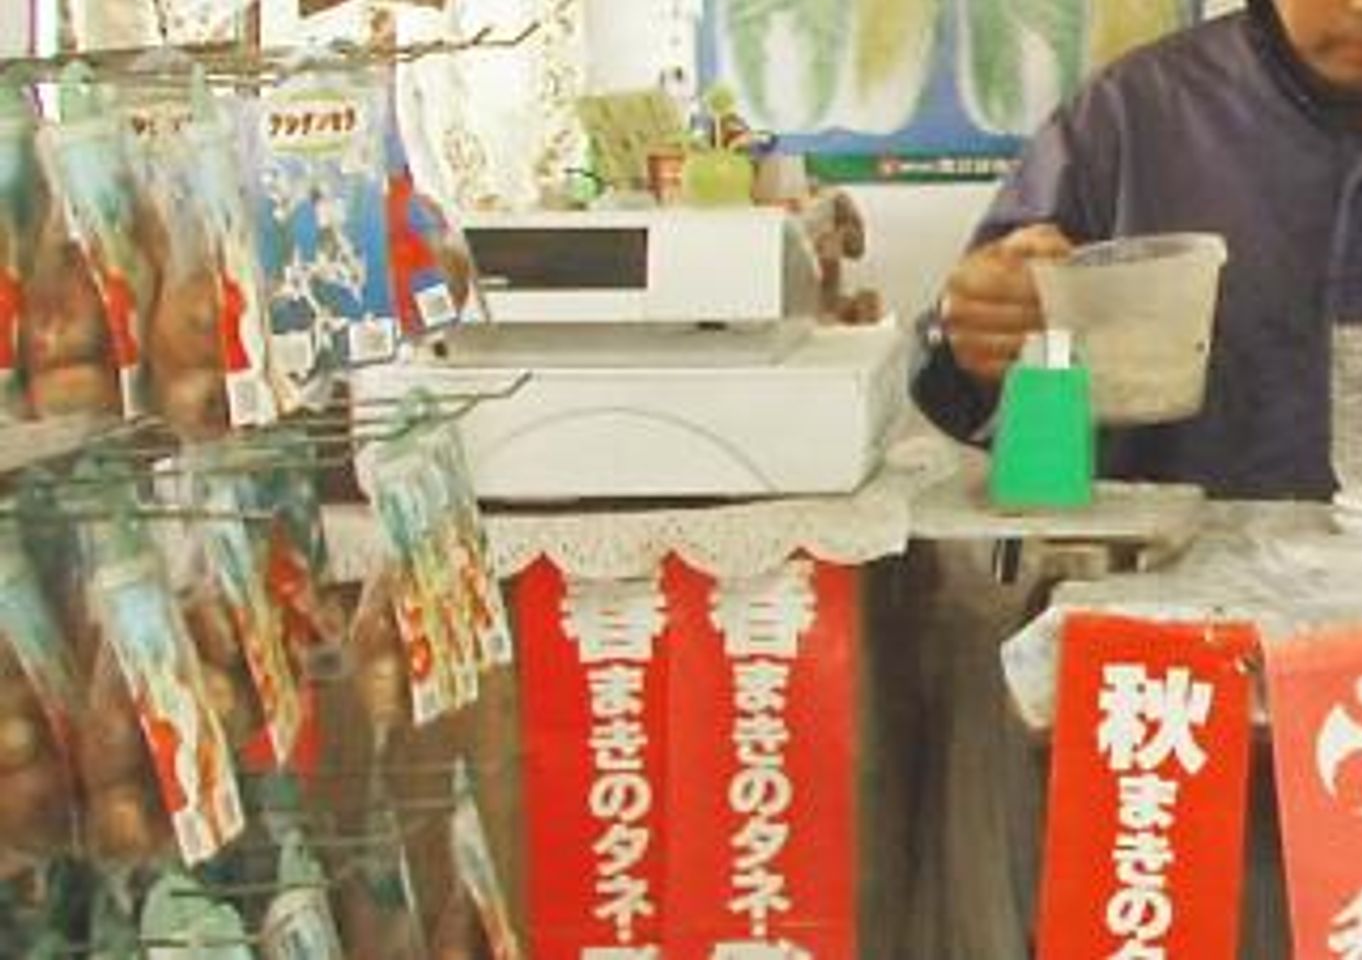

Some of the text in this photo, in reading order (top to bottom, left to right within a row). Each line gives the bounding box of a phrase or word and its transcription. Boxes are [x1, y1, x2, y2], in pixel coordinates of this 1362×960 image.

[559, 574, 669, 960] 春まきのタネ
[709, 570, 816, 960] 春まきのタネ
